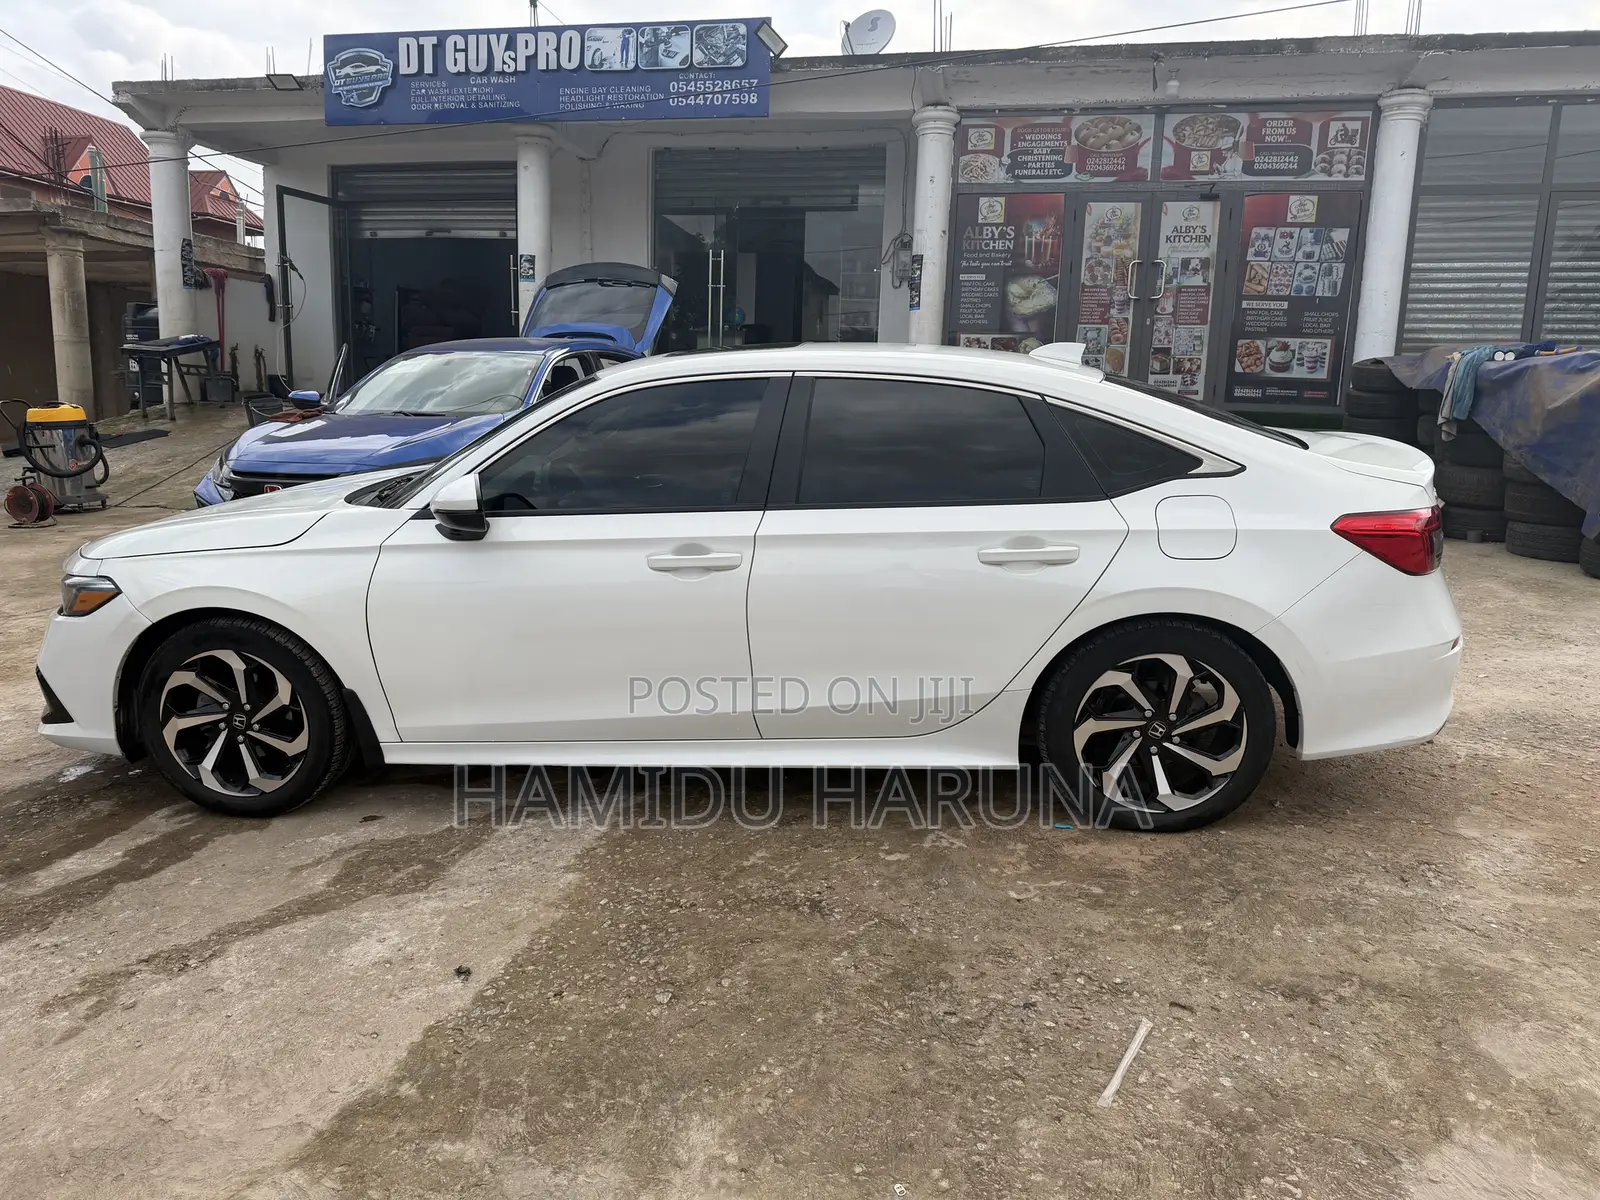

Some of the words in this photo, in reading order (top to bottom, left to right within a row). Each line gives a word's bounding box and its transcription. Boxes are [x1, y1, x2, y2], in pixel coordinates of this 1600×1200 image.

[398, 36, 438, 75] DT
[470, 76, 488, 85] CAR
[490, 75, 516, 84] WASH
[592, 86, 608, 94] BAY
[610, 85, 651, 93] CLEANING
[670, 79, 758, 93] 0545528657
[560, 94, 606, 102] HEADLIGHT
[608, 92, 664, 101] RESTORATION
[670, 92, 758, 106] 0544707598
[478, 100, 520, 108] SANITIZING
[1266, 119, 1294, 128] ORDER
[1262, 127, 1285, 135] FROM
[1286, 127, 1296, 135] US
[963, 226, 1016, 239] ALBY'S
[1171, 226, 1207, 234] ALBY'S
[1166, 234, 1212, 244] KITCHEN
[962, 240, 1014, 250] KITCHEN
